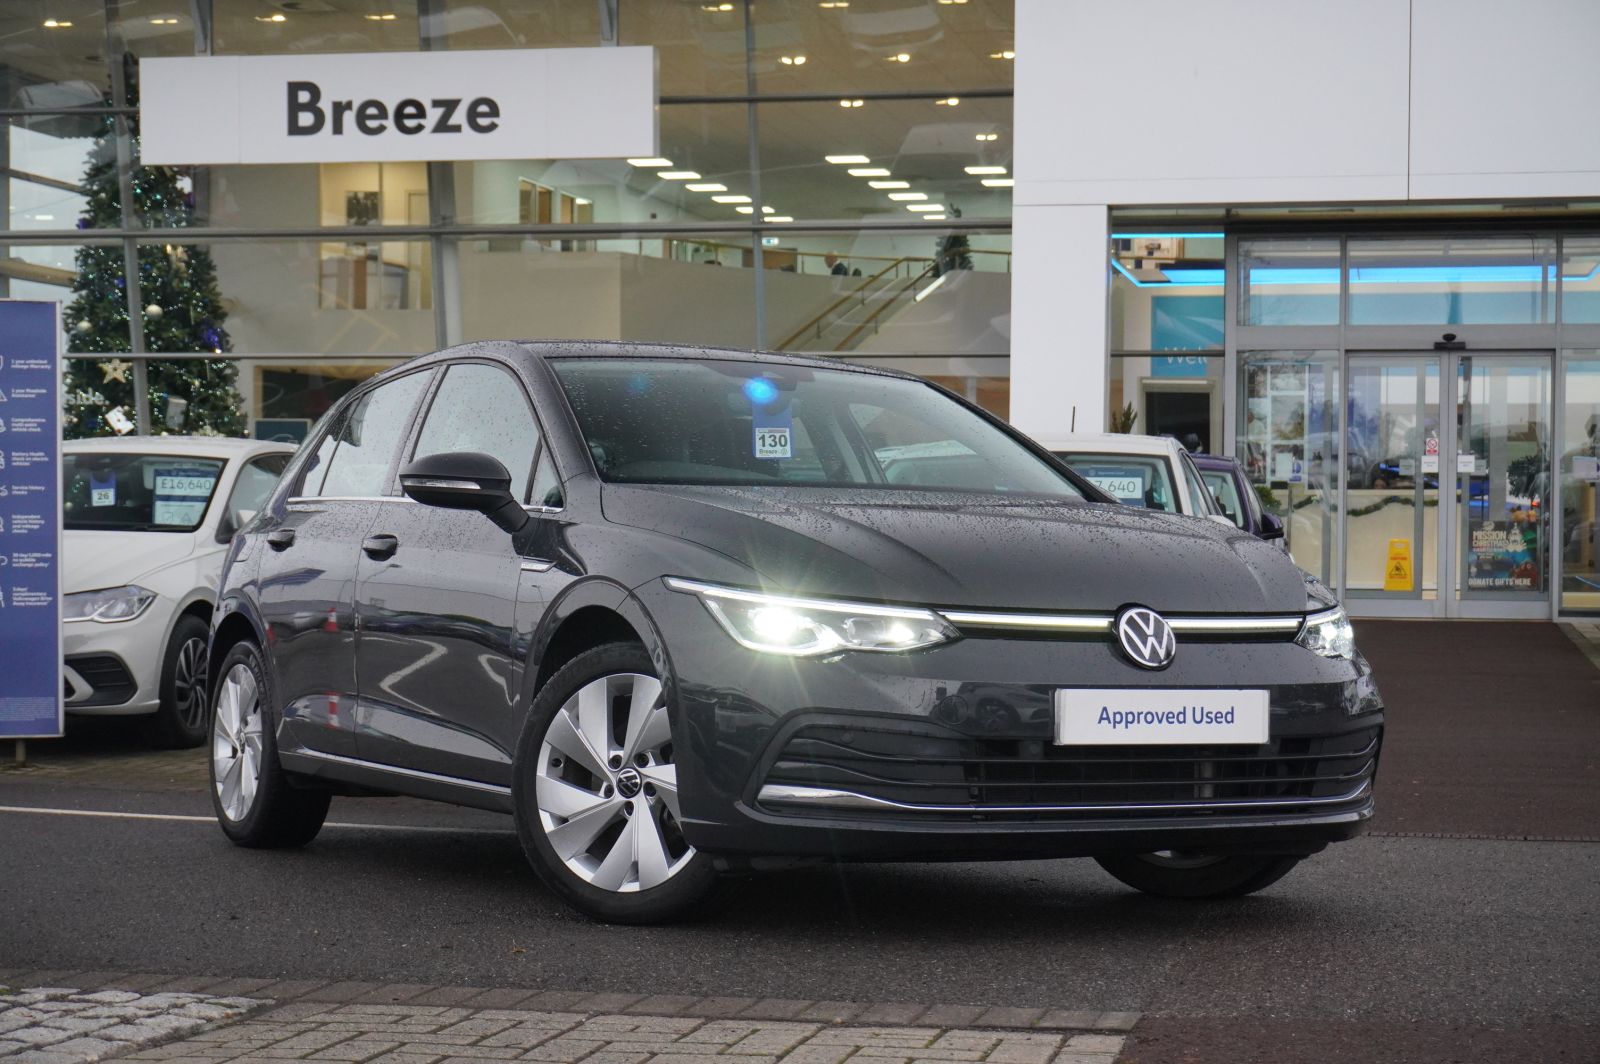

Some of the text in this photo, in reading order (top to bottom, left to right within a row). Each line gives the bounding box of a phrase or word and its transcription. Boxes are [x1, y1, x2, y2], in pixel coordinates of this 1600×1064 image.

[287, 80, 500, 136] Breeze
[758, 434, 788, 448] 130
[97, 492, 109, 500] 26
[1472, 530, 1507, 540] MISSION
[1514, 578, 1532, 586] HERE
[1097, 706, 1235, 729] Approved Used
